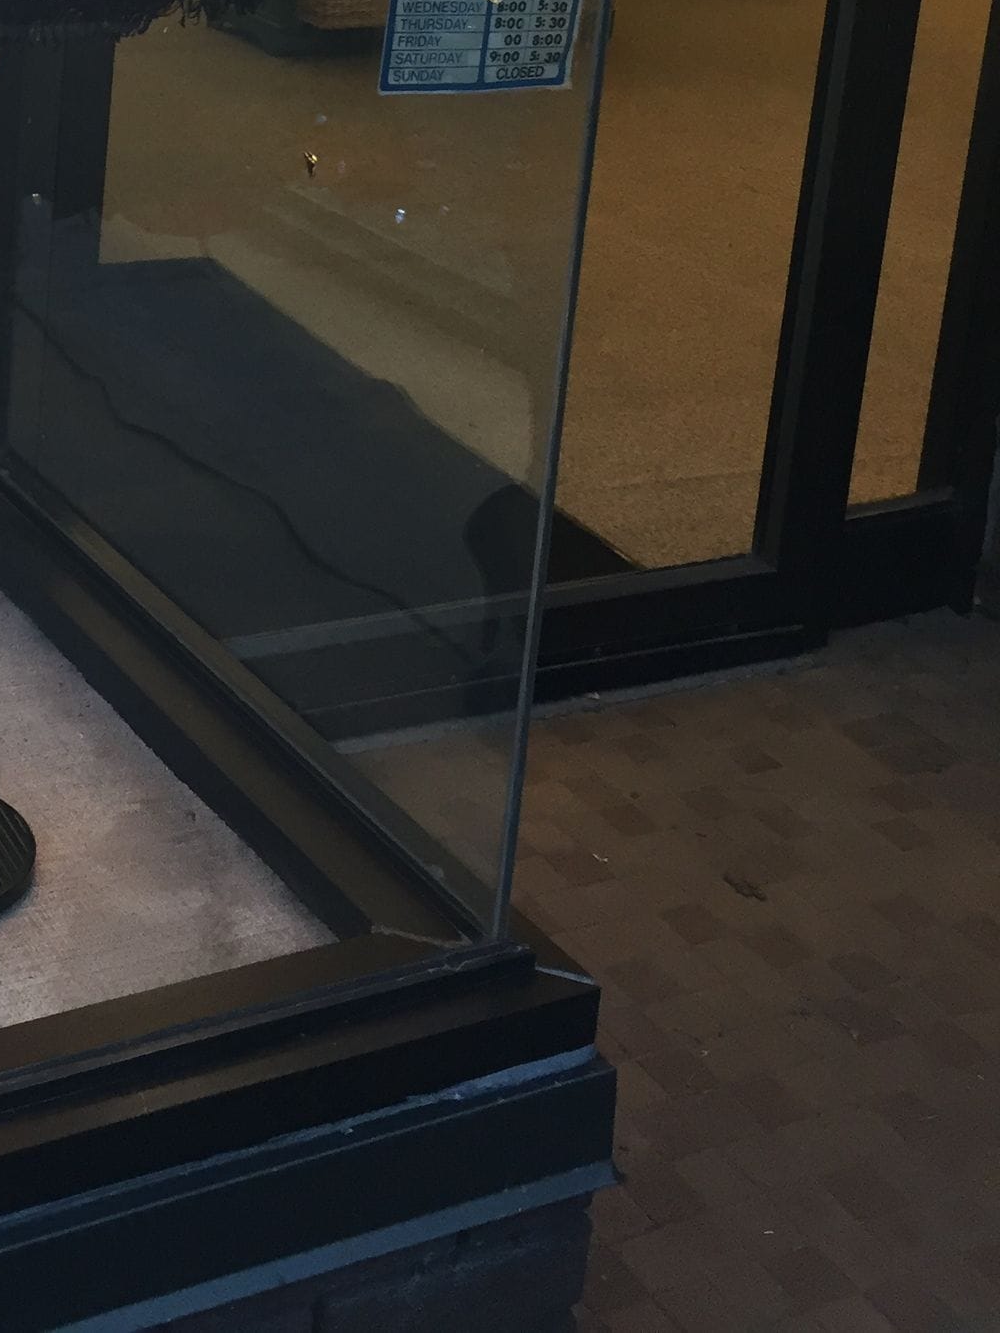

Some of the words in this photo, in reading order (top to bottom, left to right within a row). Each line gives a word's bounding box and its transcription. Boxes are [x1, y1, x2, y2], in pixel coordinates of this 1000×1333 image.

[402, 1, 483, 13] WEDNESDAY
[400, 18, 469, 31] THURSDAY
[397, 35, 443, 48] FRIDAY
[394, 51, 464, 65] SATURDAY
[392, 69, 445, 82] SUNDAY
